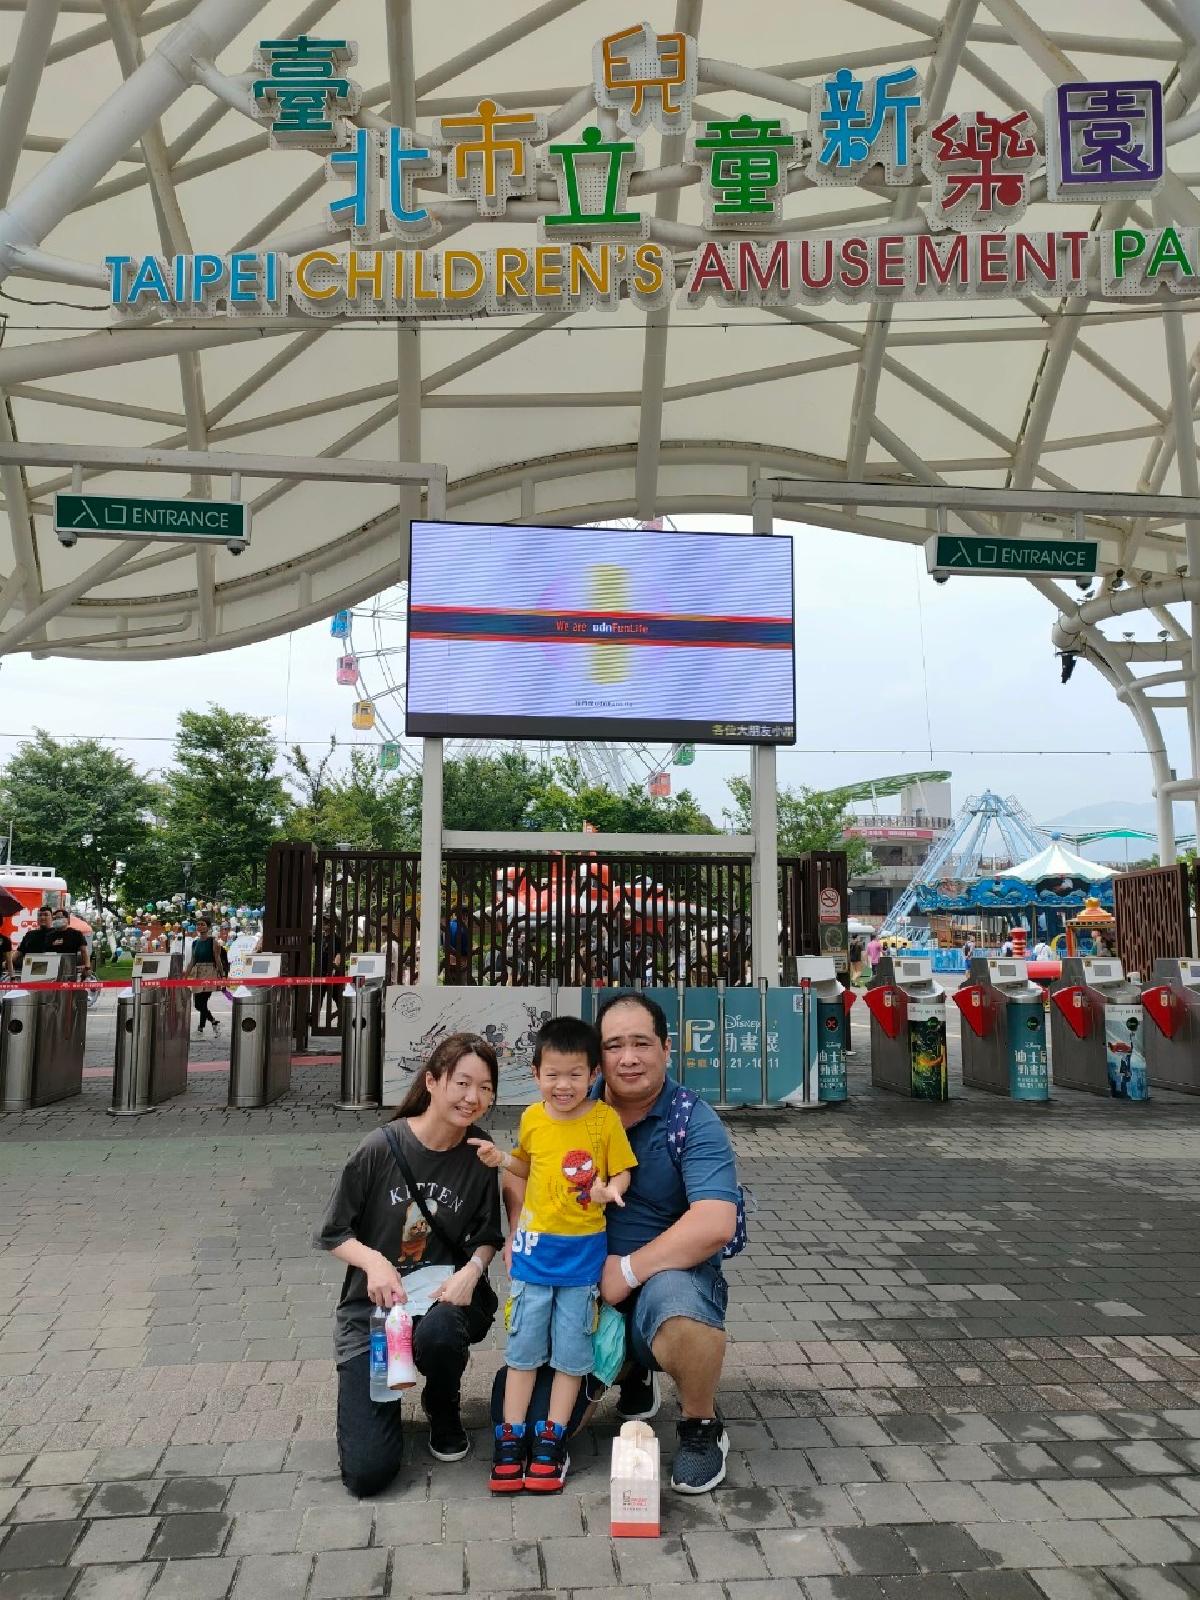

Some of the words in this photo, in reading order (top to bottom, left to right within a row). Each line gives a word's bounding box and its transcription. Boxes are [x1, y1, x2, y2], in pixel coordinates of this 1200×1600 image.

[104, 251, 277, 303] TAIPEI
[295, 244, 665, 300] CHILDREN'S
[690, 230, 1089, 293] AMUSEMENT
[1113, 227, 1196, 278] PA
[72, 499, 127, 526] 入口
[132, 507, 230, 528] ENTRANCE
[950, 540, 998, 566] 入口
[1001, 547, 1087, 567] ENTRANCE
